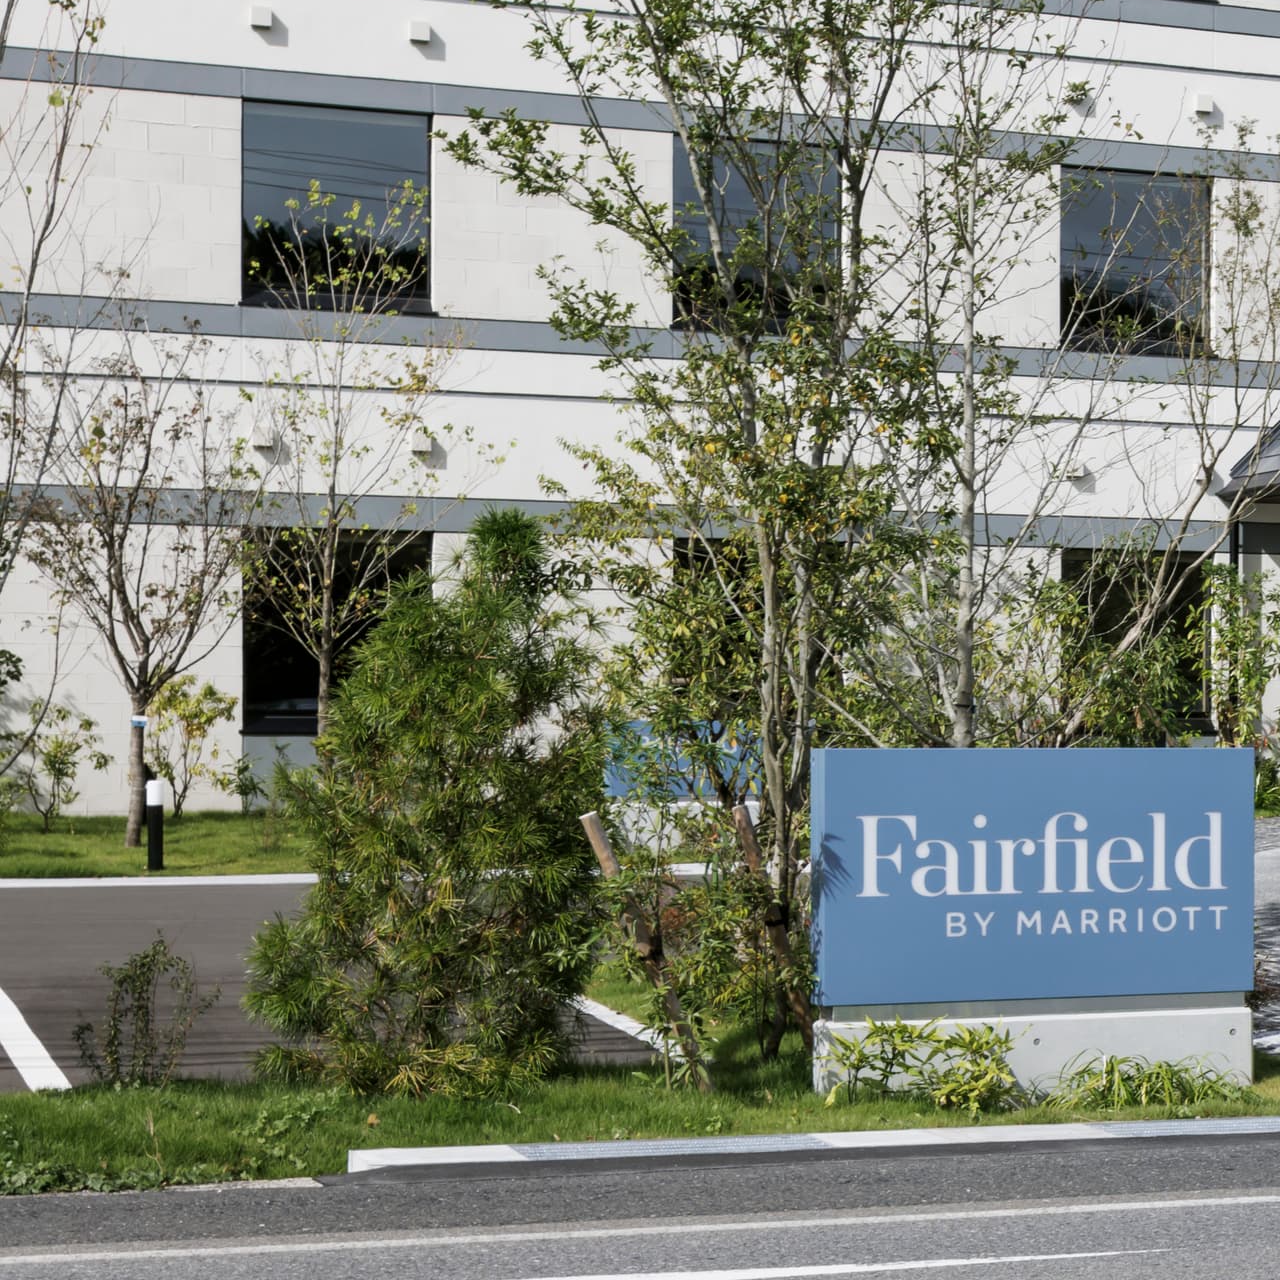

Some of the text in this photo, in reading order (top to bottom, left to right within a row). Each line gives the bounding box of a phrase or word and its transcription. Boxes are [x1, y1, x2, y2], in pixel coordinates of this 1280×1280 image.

[855, 811, 1228, 898] Fairfield
[946, 906, 1228, 938] BY MARRIOTT
